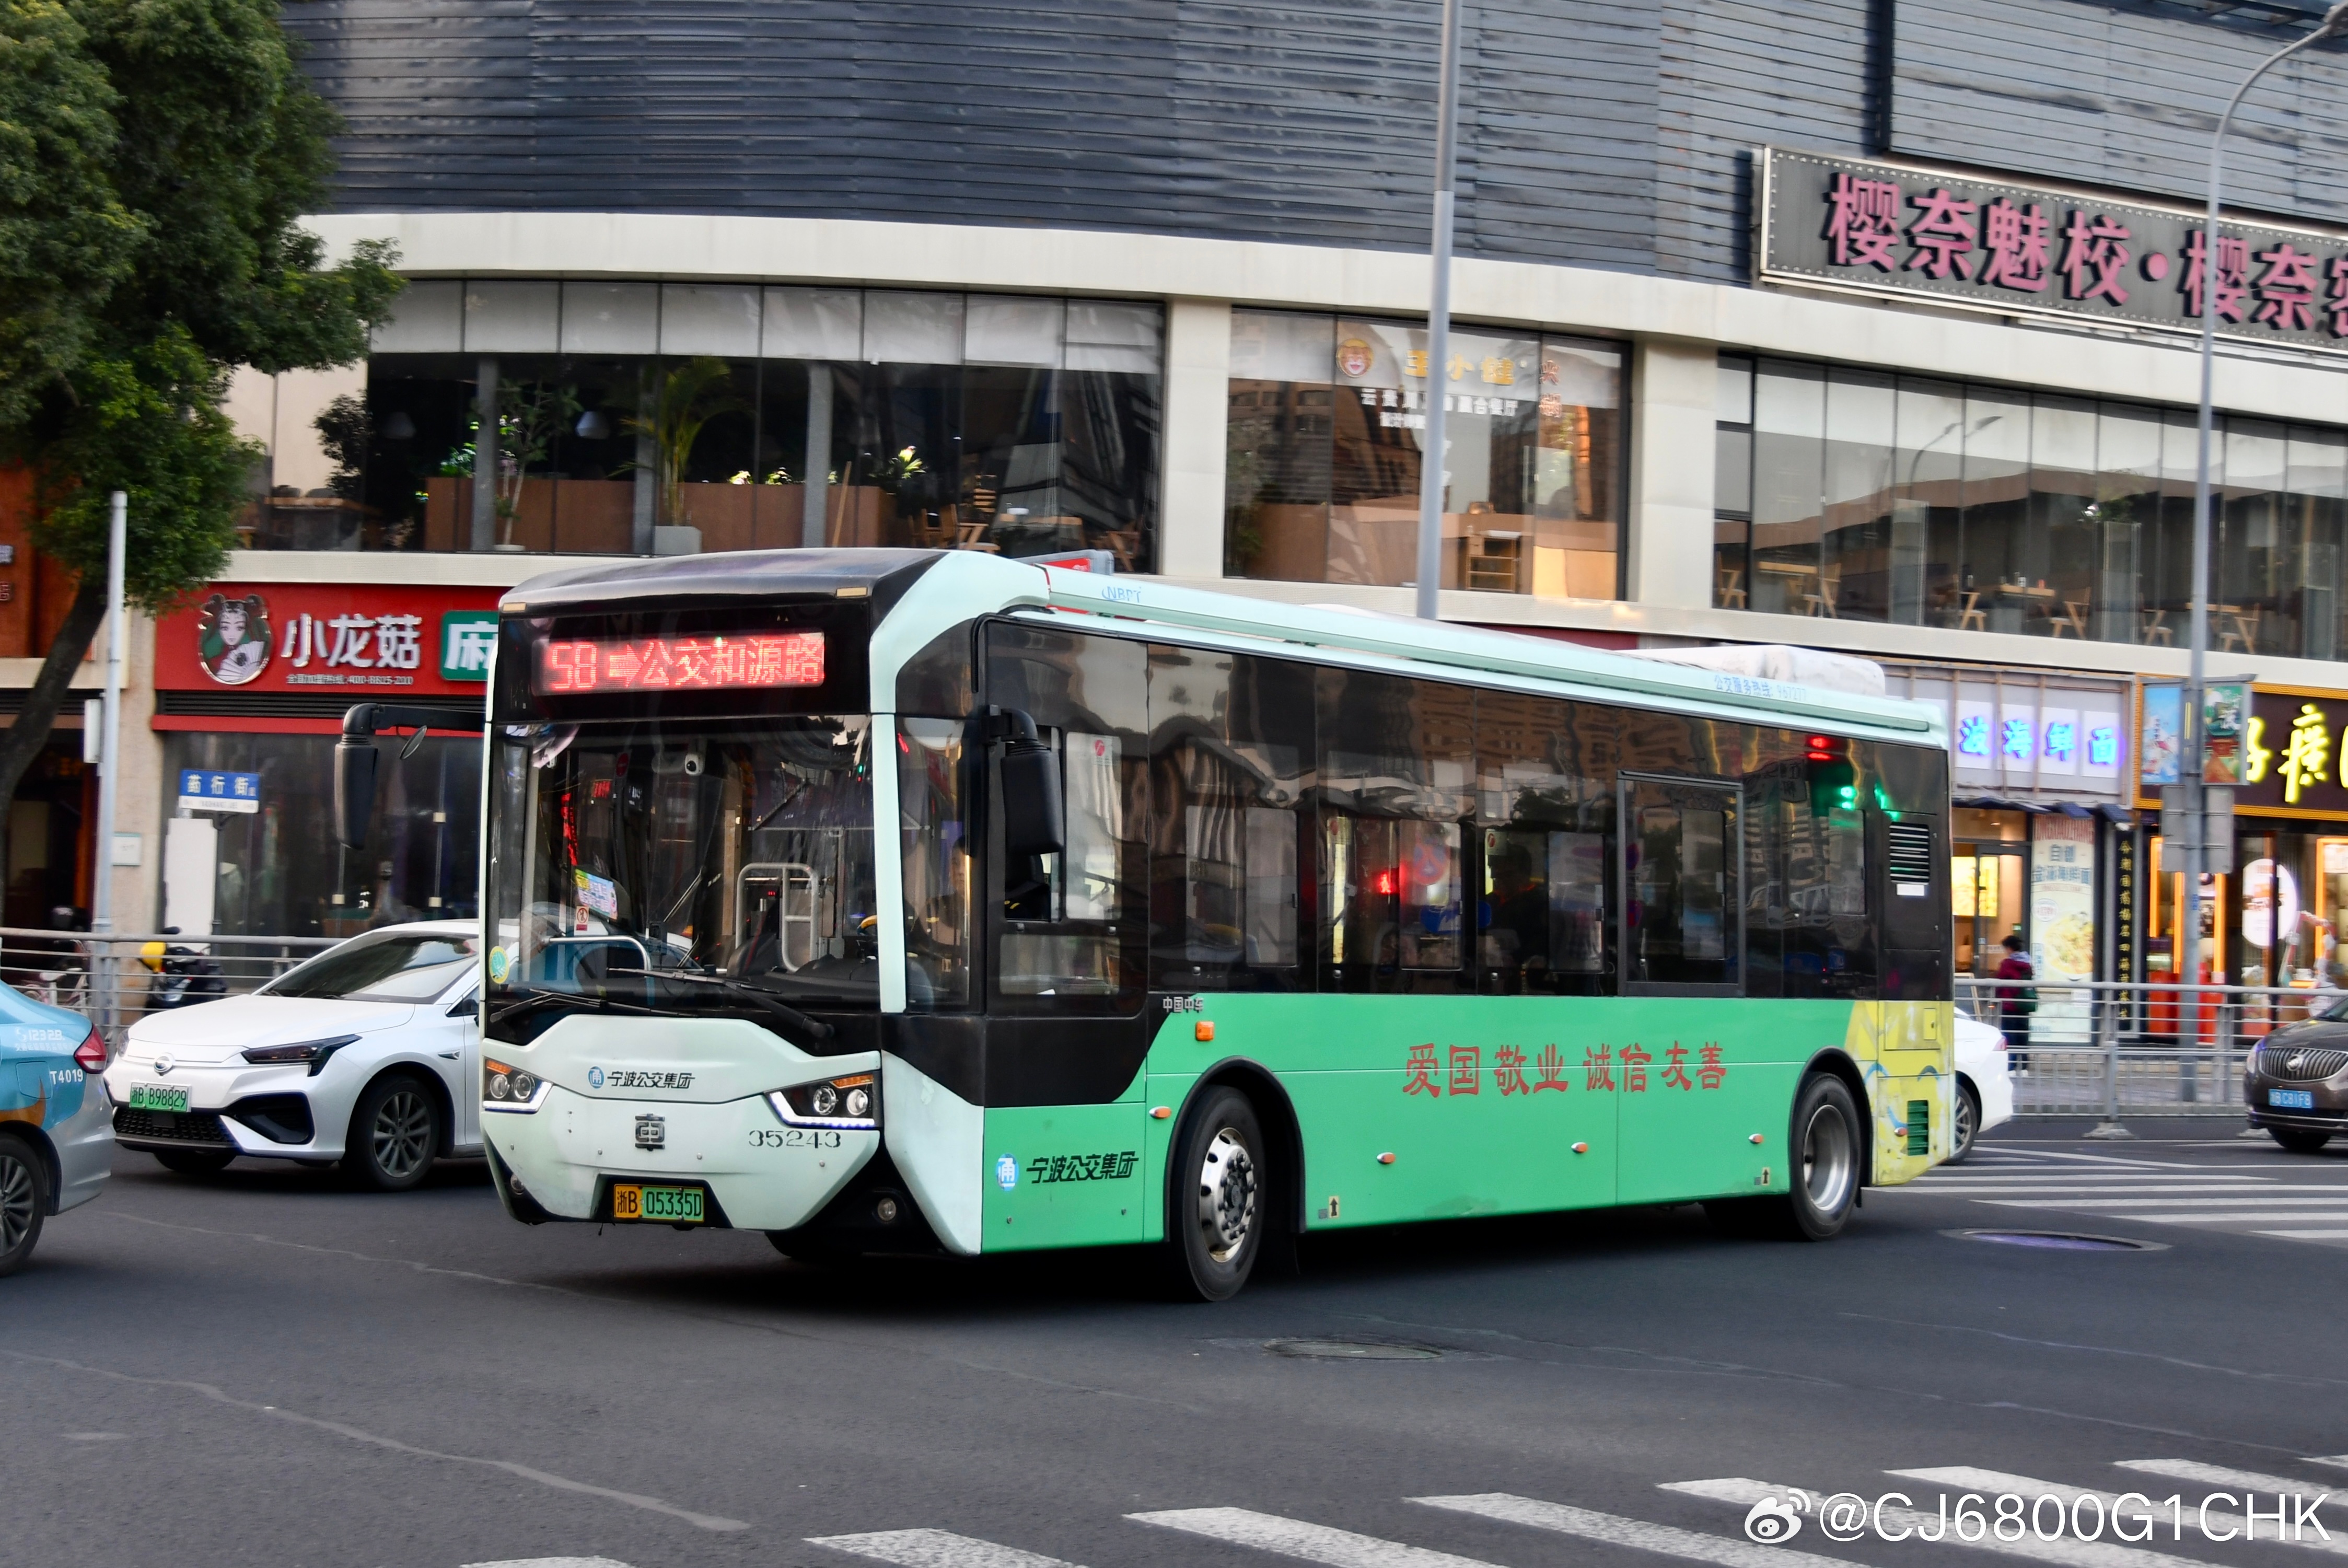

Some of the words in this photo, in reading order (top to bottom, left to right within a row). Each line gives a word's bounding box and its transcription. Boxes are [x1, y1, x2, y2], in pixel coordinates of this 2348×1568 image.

[281, 612, 422, 669] 小龙菇
[552, 642, 597, 689] 58
[642, 637, 824, 686] 公交和源路
[1163, 996, 1204, 1013] 中国中车
[50, 1068, 84, 1085] T4019
[607, 1071, 696, 1089] 宁波公交集团
[1402, 1042, 1481, 1098] 爱国
[1493, 1043, 1568, 1096] 敬业
[1582, 1042, 1652, 1093] 诚信
[1660, 1040, 1727, 1091] 友善
[748, 1129, 841, 1149] 35243
[1026, 1151, 1140, 1184] 宁波公交集团
